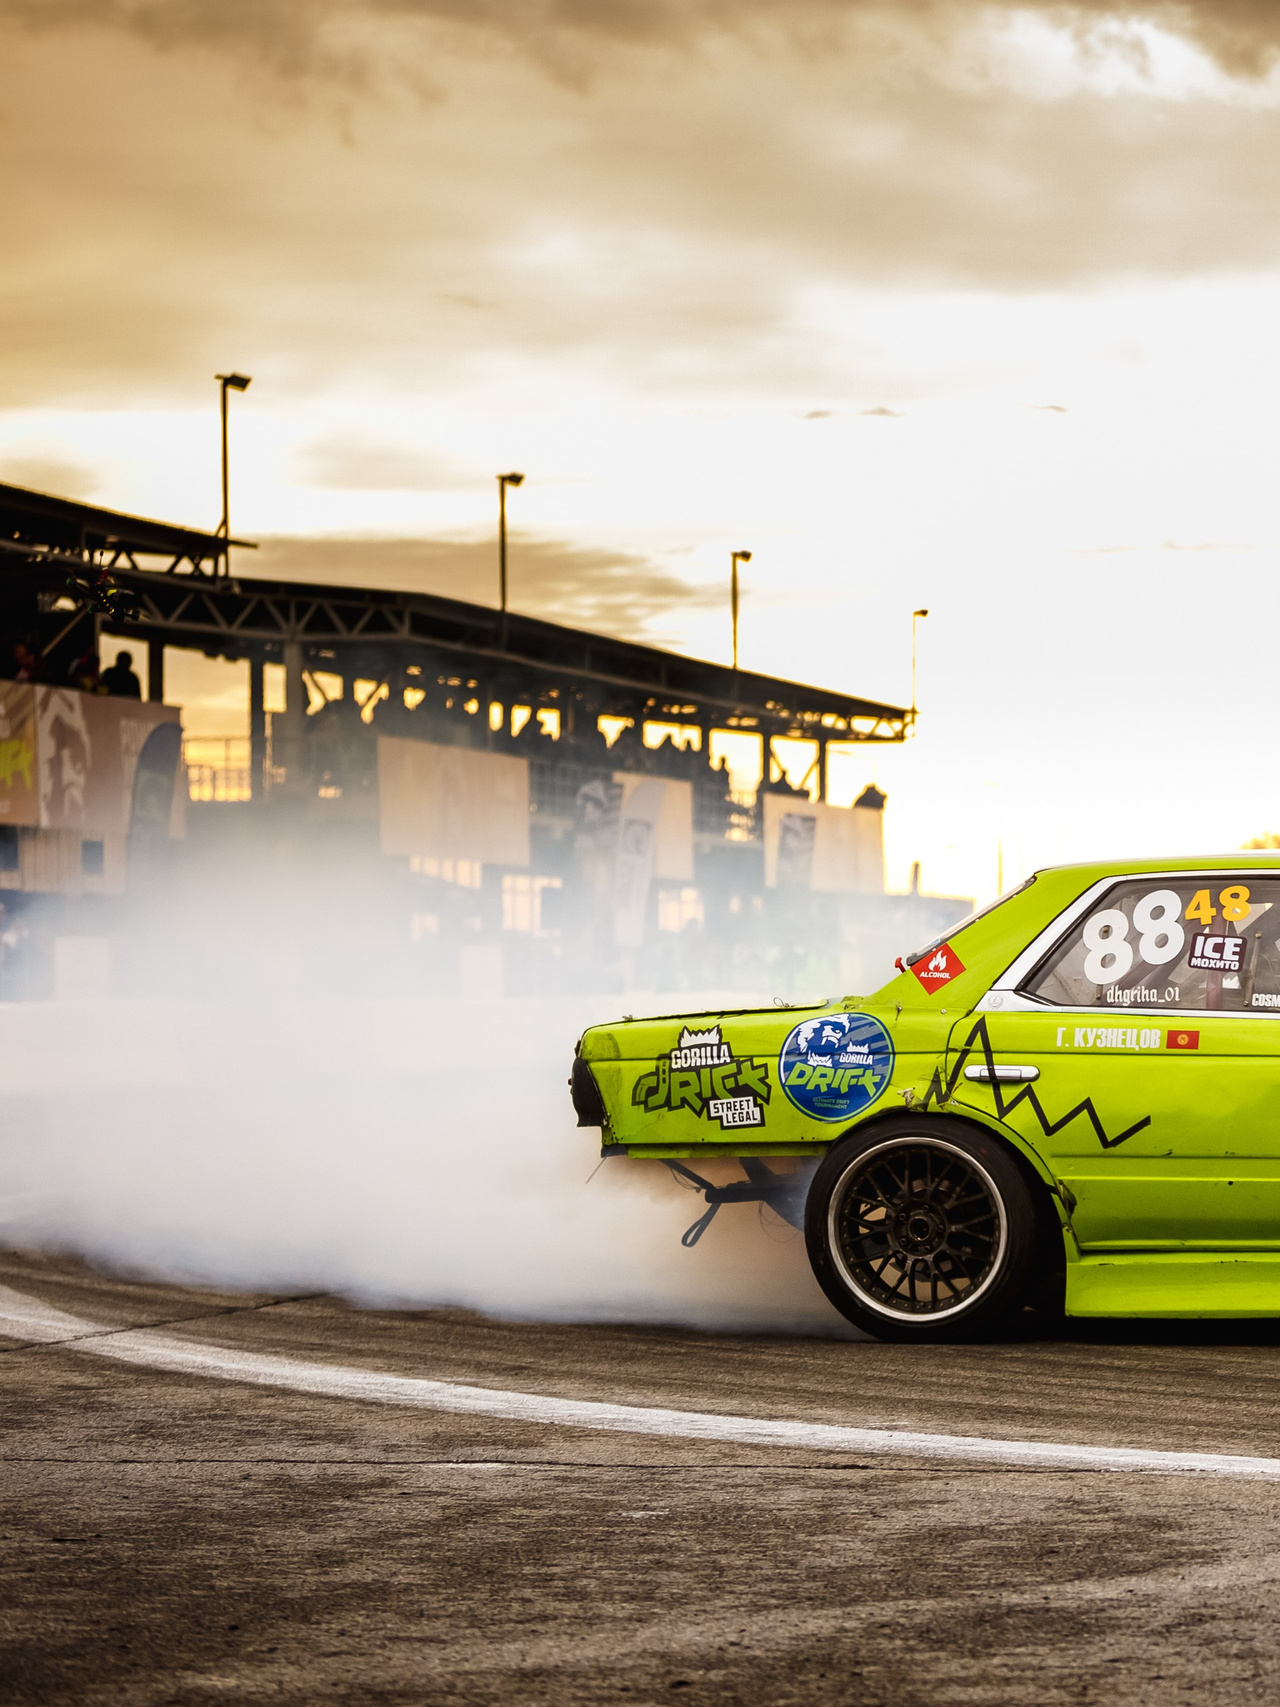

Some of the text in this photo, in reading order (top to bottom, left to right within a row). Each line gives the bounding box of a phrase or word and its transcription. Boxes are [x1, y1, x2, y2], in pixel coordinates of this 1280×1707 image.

[1185, 885, 1250, 925] 48
[1082, 889, 1185, 985] 88
[1194, 936, 1242, 961] ICE
[919, 971, 951, 979] ALCOHOL
[1190, 957, 1240, 971] МОХИТО
[1056, 1027, 1162, 1051] Г. КУЗНЕЦОВ
[671, 1044, 731, 1069] GORILLA
[839, 1052, 874, 1065] GORILLA
[785, 1062, 882, 1098] DRIFT
[713, 1099, 751, 1114] STREET
[725, 1110, 758, 1124] LEGAL
